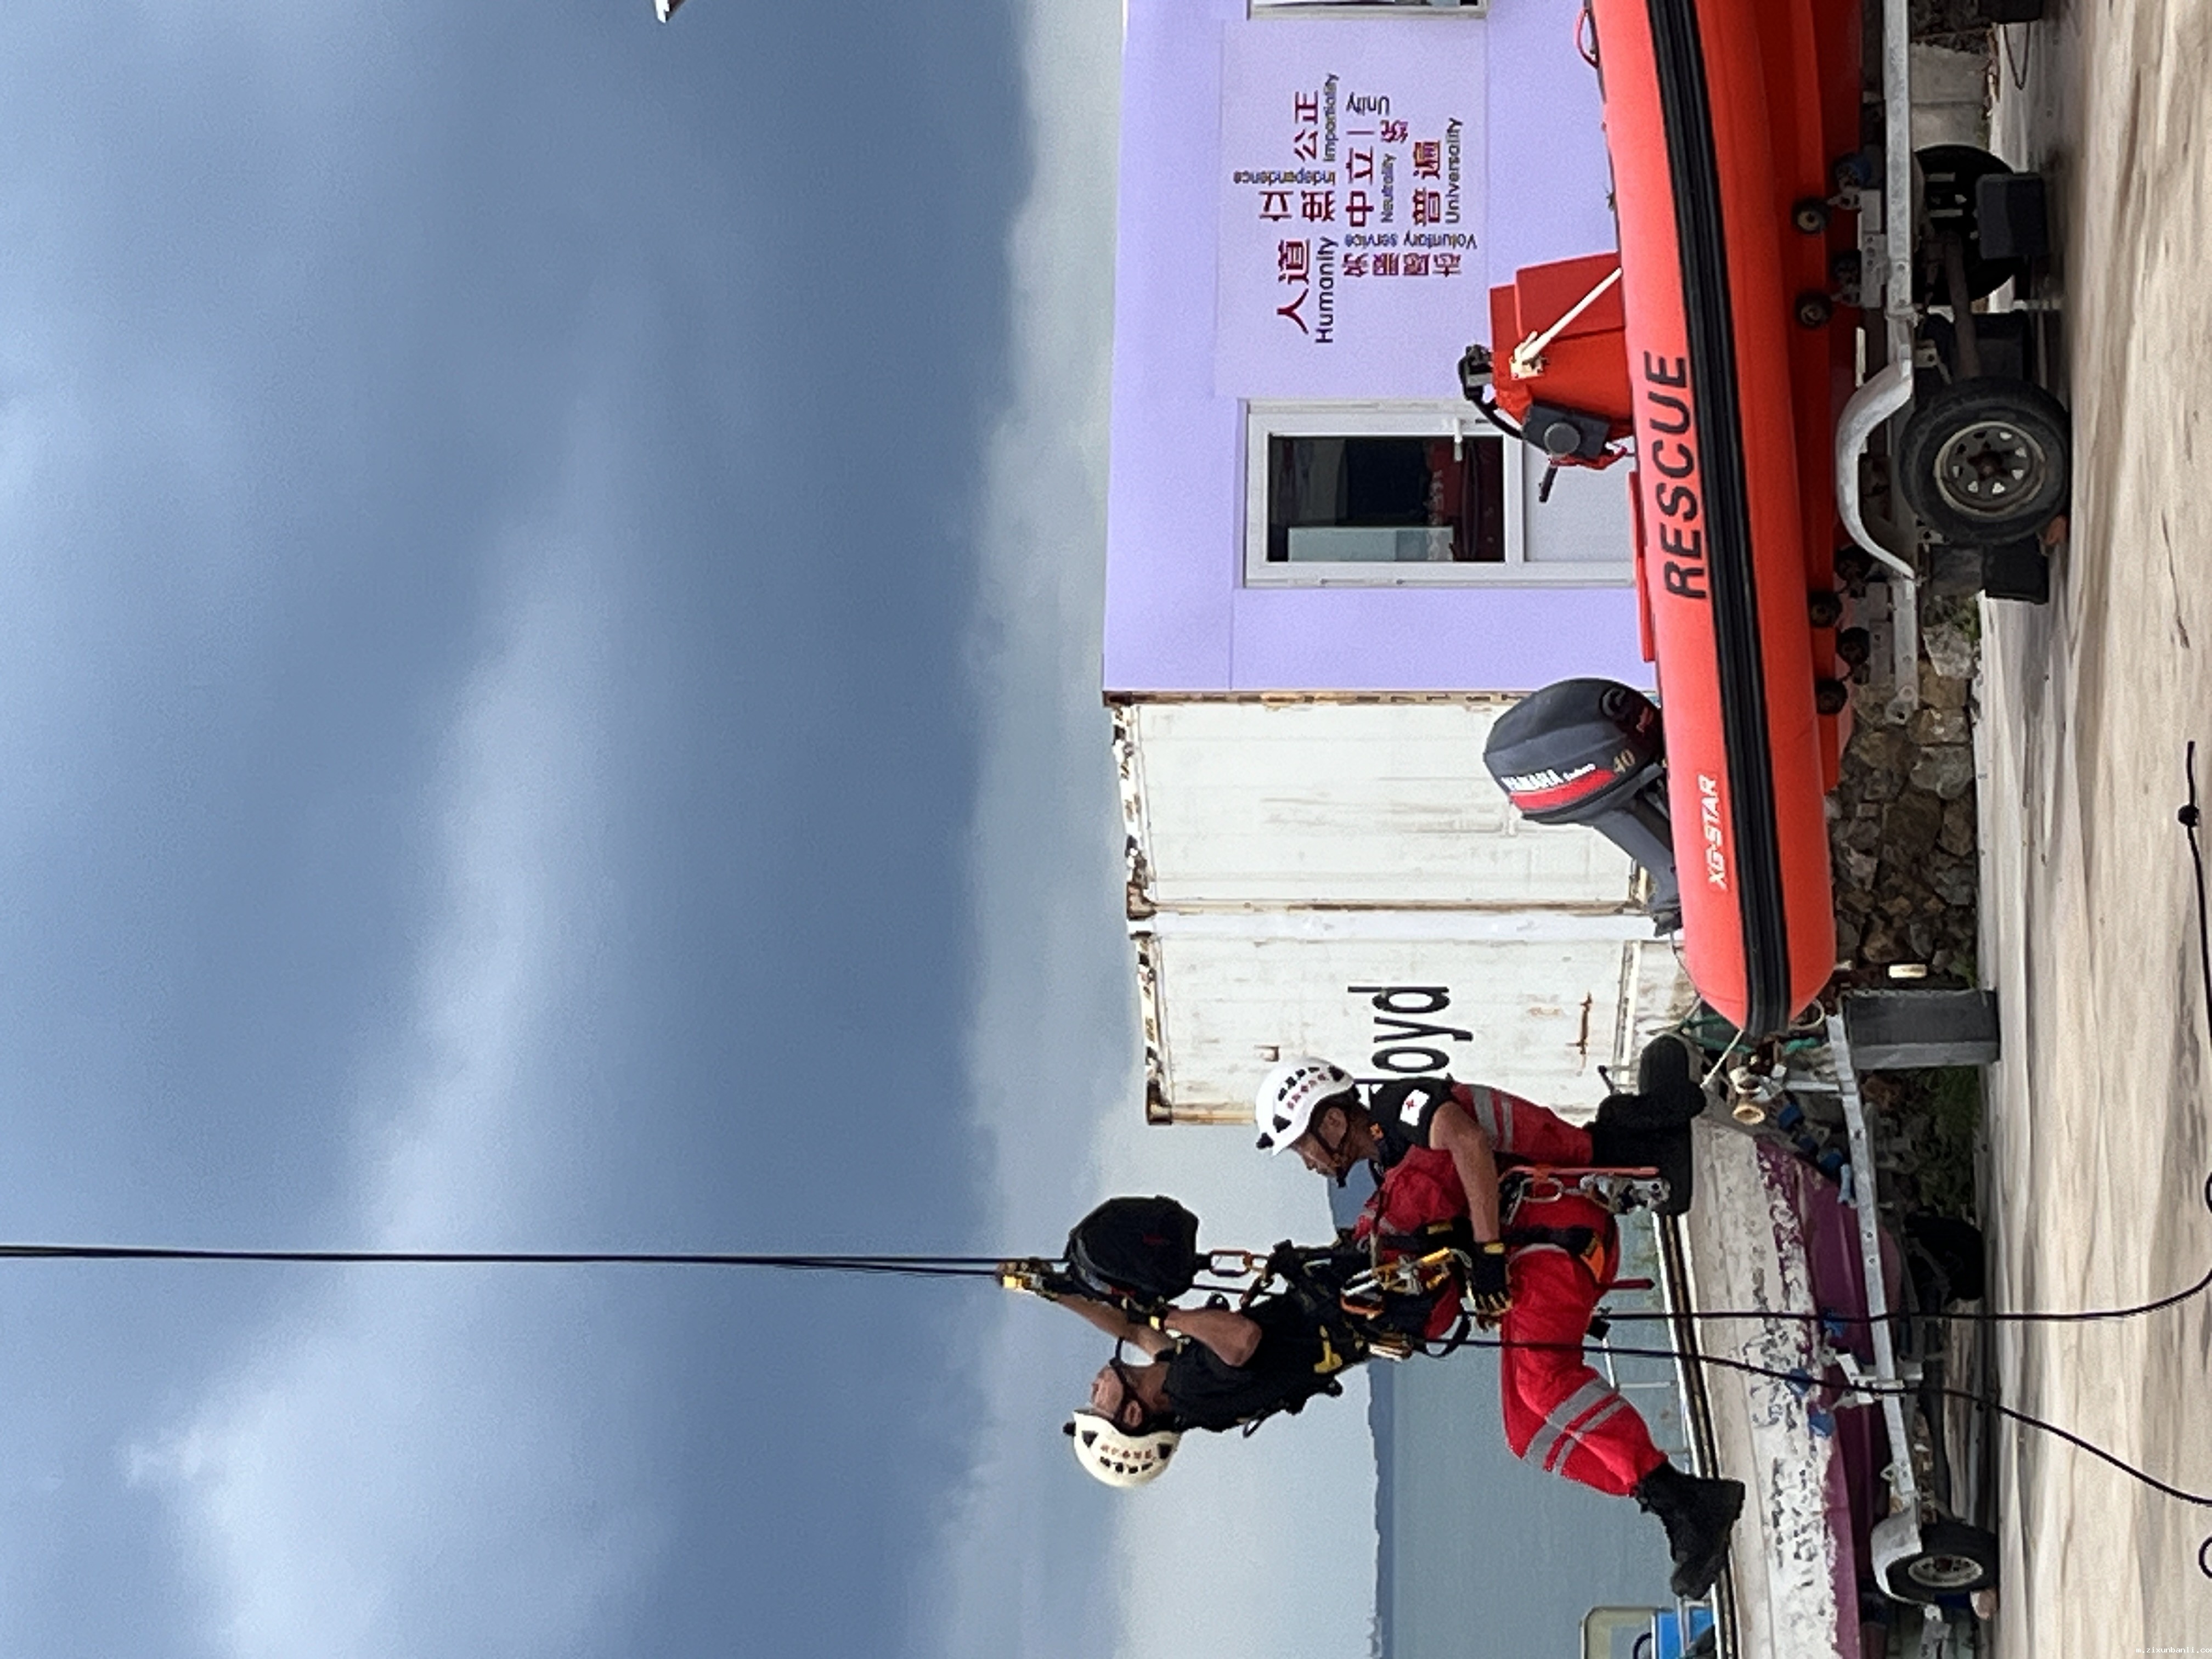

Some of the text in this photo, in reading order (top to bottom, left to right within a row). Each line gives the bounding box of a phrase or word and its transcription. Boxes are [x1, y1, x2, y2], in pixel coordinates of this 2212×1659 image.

[1294, 91, 1318, 161] 公正
[1323, 74, 1339, 161] Impartiality
[1346, 92, 1390, 115] Unity
[1259, 190, 1335, 222] 独立
[1346, 146, 1374, 227] 中立
[1381, 154, 1396, 222] Neutrality
[1413, 140, 1441, 226] 普遍
[1446, 117, 1463, 223] Universality
[1342, 253, 1462, 277] 志愿服务
[1345, 230, 1477, 249] Voluntary service
[1277, 239, 1310, 335] 人道
[1316, 236, 1339, 343] Humanity
[1644, 351, 1706, 599] RESCUE
